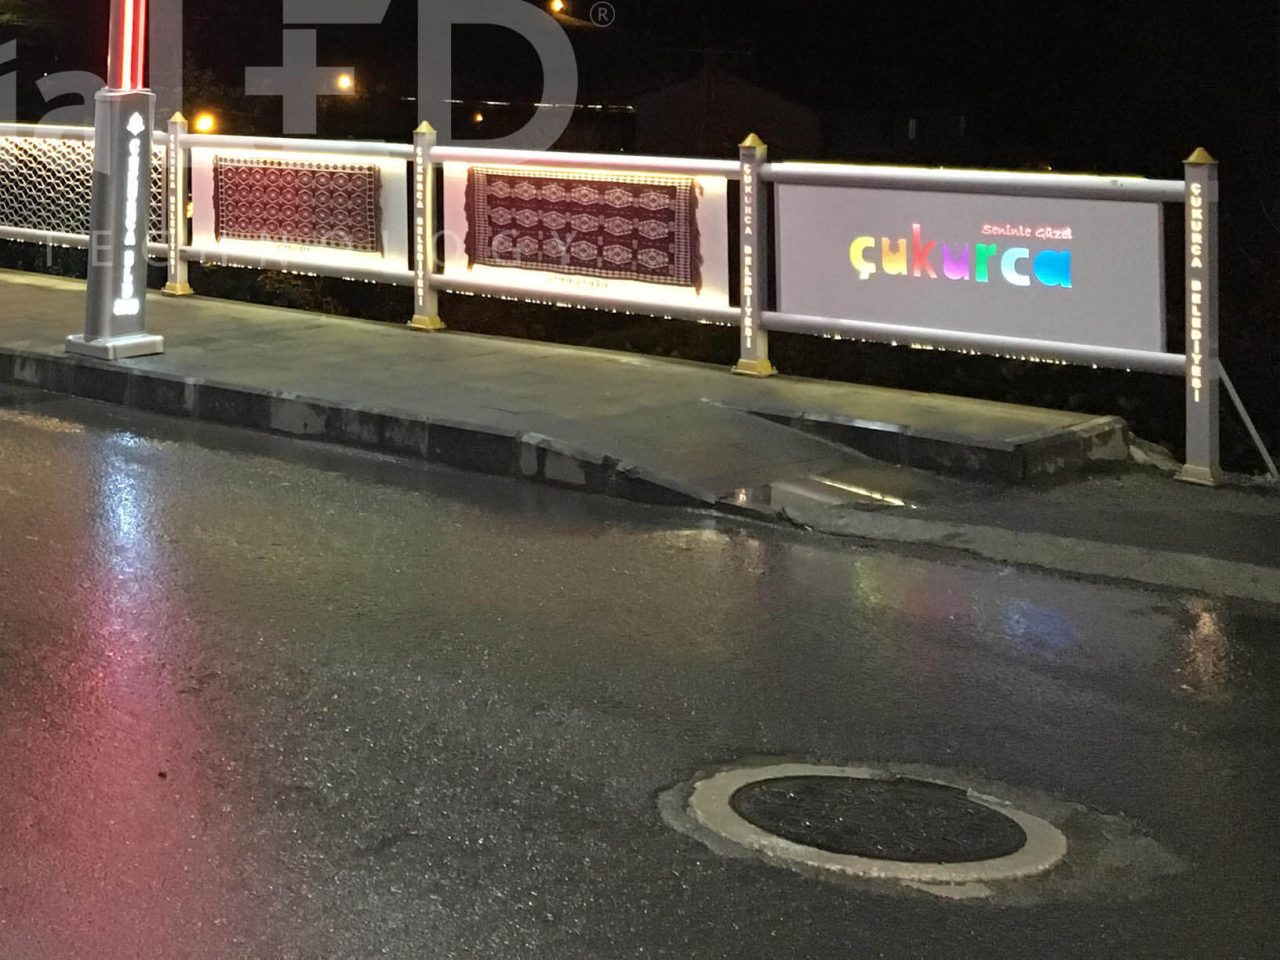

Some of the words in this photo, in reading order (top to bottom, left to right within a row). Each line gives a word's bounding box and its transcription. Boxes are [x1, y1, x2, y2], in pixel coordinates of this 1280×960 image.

[743, 163, 753, 235] ÇUKURCA
[1190, 182, 1203, 269] ÇUKURCA
[849, 223, 1073, 288] çukurca
